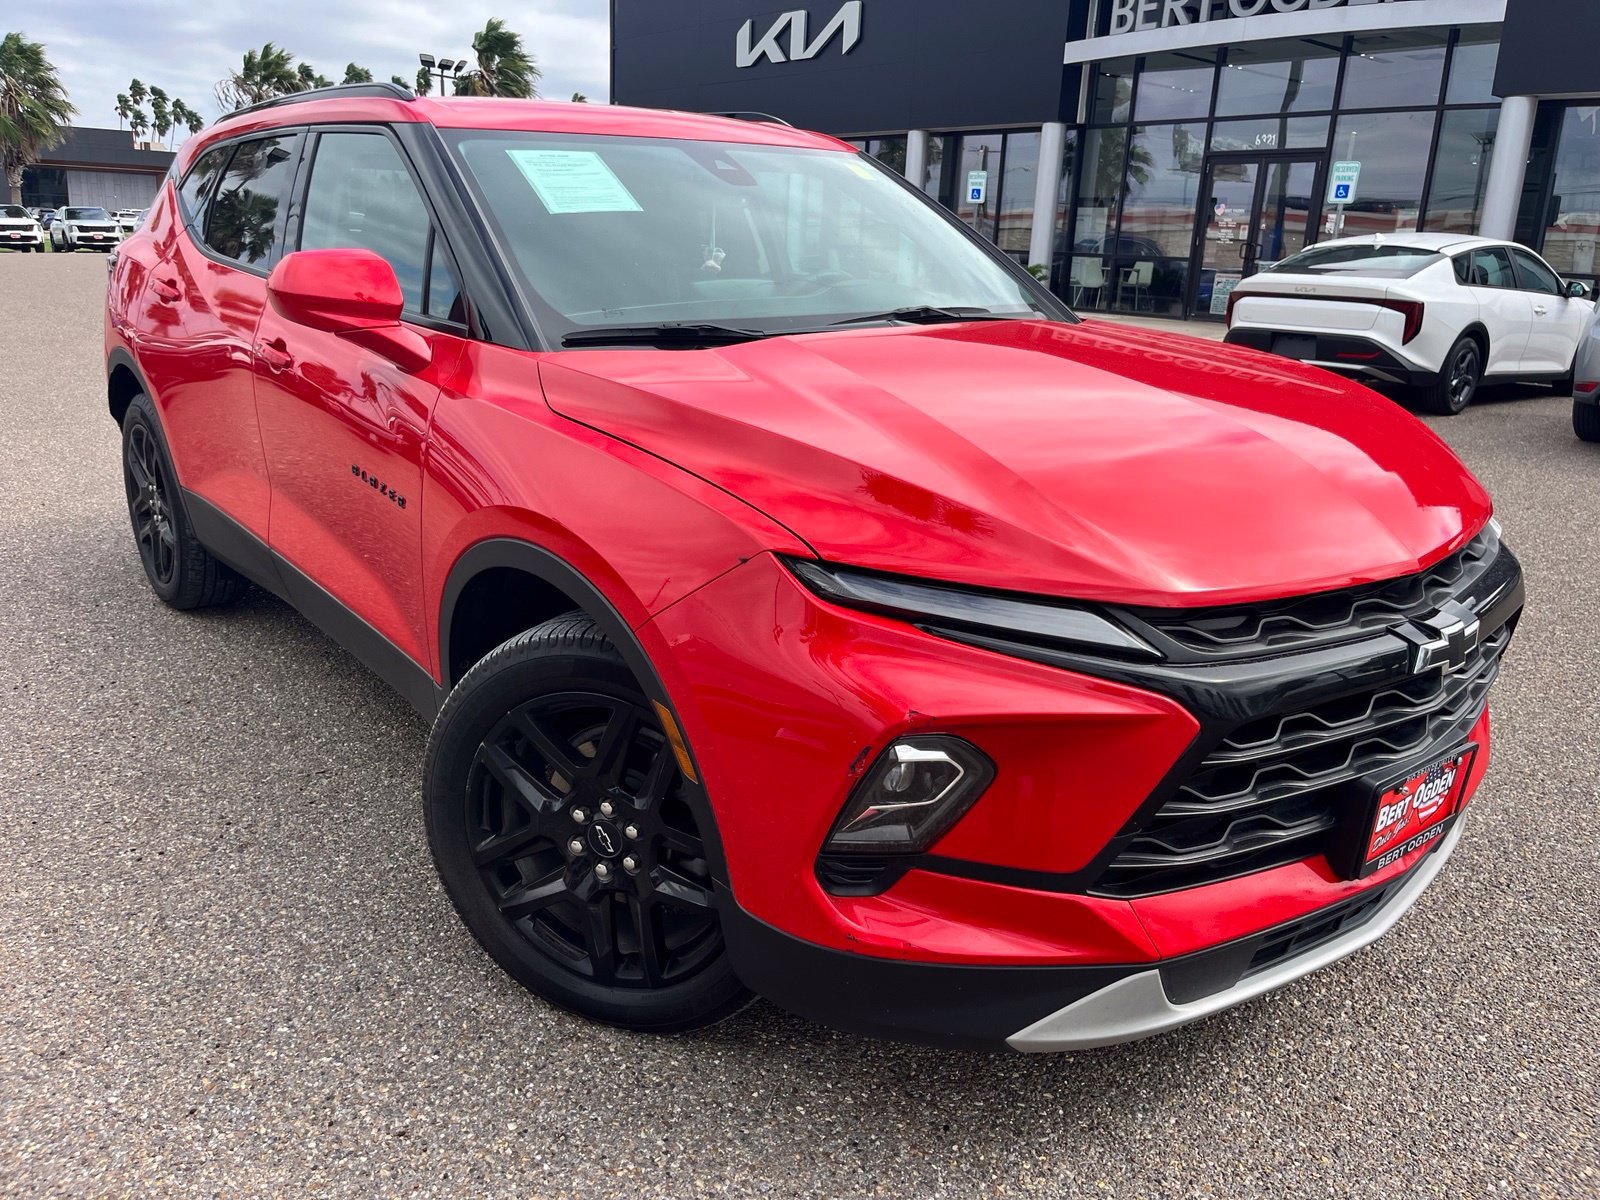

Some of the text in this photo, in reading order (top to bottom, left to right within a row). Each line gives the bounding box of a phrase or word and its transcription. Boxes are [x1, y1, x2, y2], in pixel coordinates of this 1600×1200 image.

[736, 0, 862, 68] KIA
[351, 464, 407, 509] BLAZER
[1375, 768, 1456, 833] BERT OGDEN
[1377, 824, 1444, 869] BERT OGDEN
